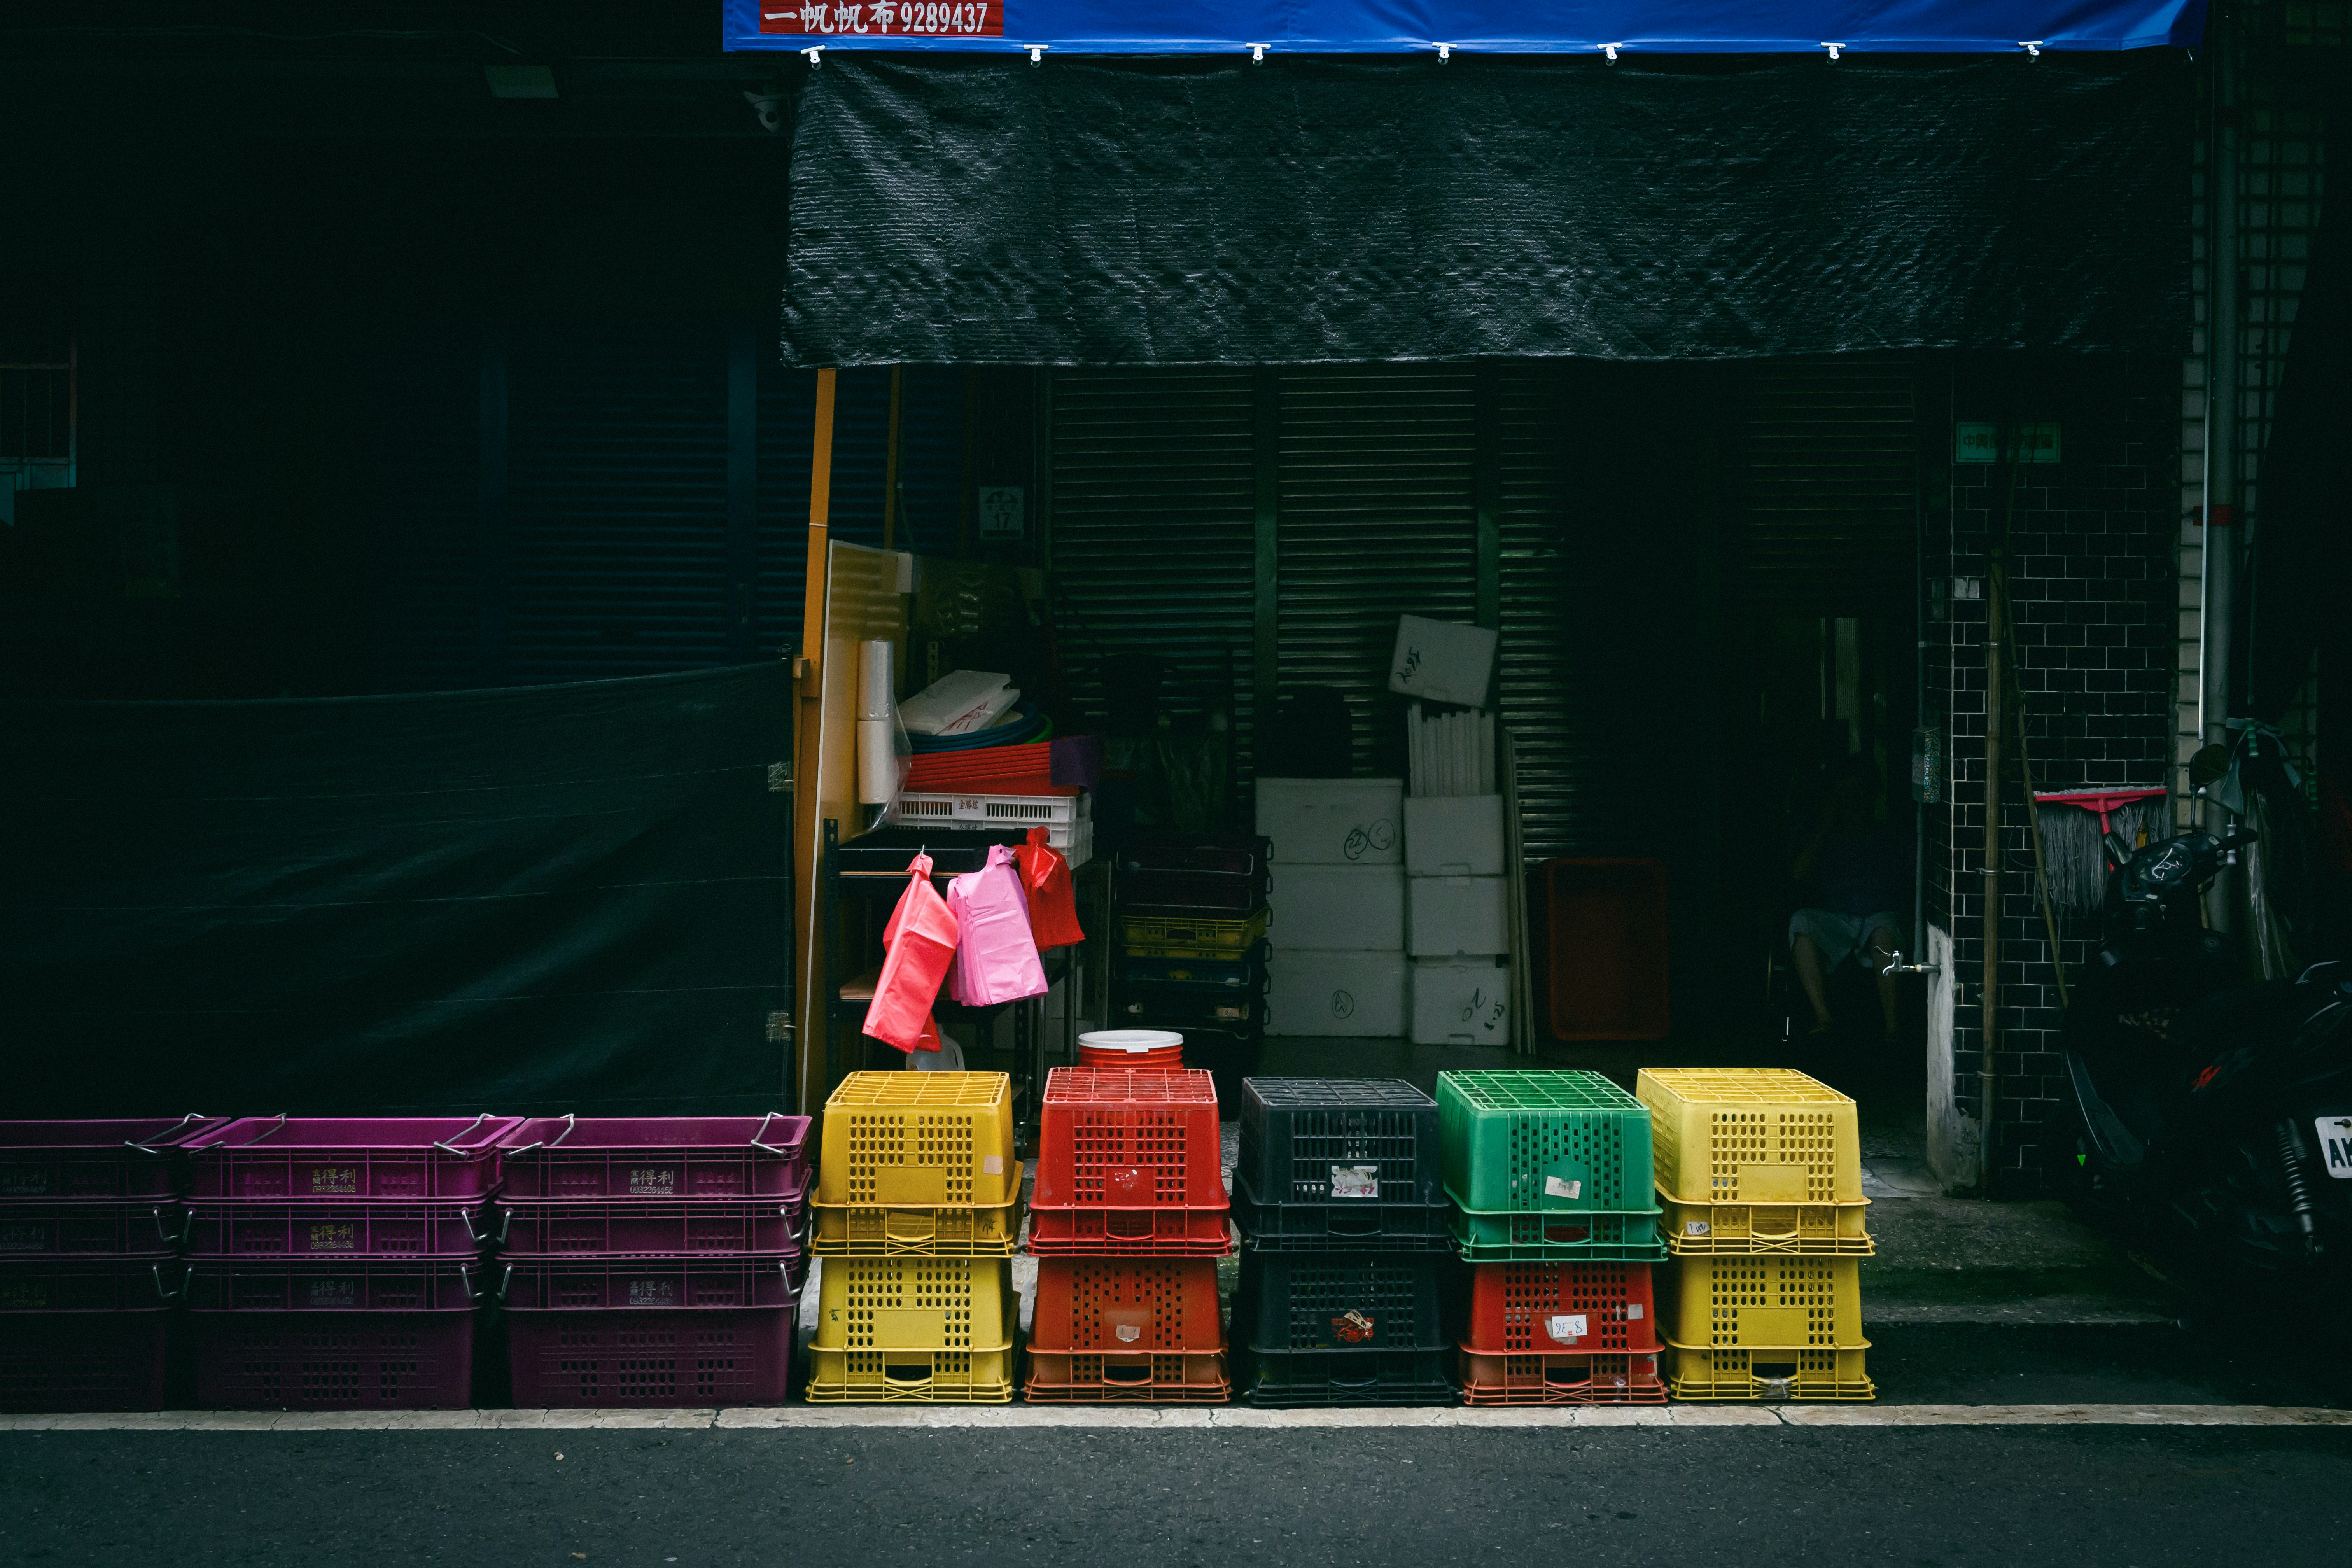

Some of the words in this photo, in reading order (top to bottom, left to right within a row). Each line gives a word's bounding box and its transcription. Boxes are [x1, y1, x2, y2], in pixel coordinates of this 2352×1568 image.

[764, 0, 898, 34] 一帆帆布
[901, 3, 987, 33] 9289437
